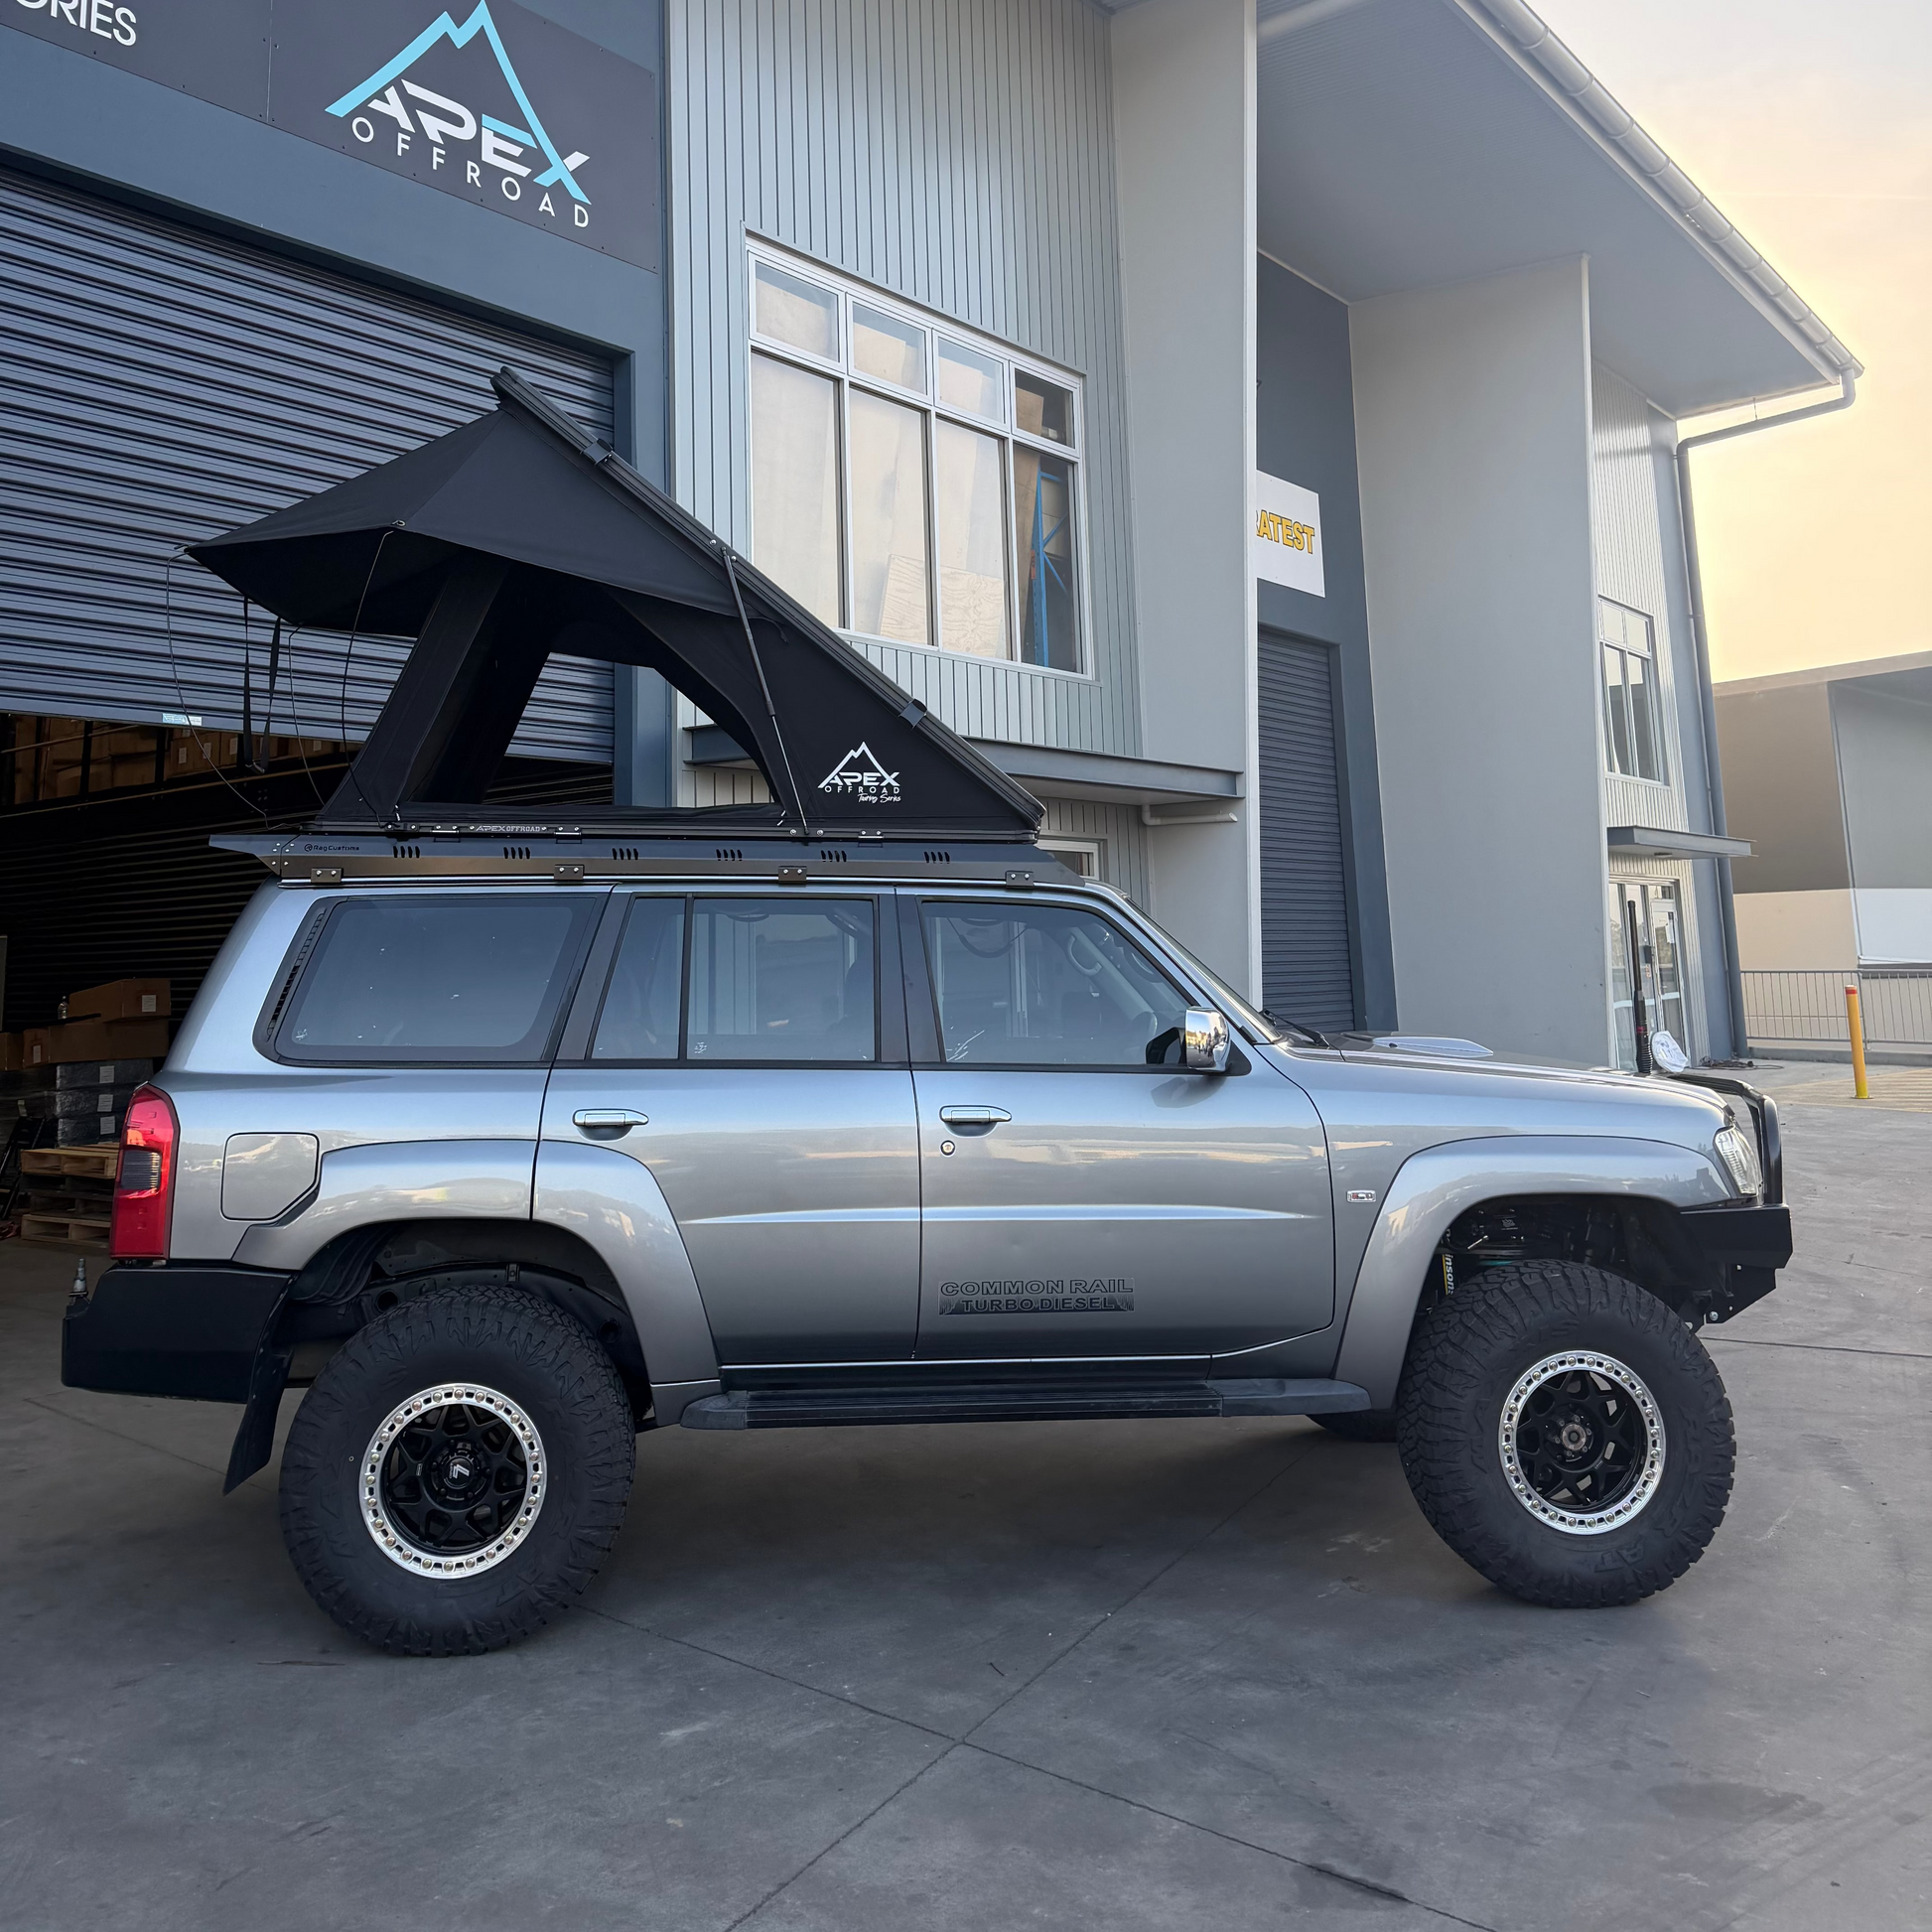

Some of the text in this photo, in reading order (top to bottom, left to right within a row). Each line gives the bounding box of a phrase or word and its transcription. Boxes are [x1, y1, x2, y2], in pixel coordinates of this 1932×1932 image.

[16, 0, 137, 47] RIES
[365, 77, 593, 206] APEX
[350, 116, 590, 228] OFFROAD
[1255, 508, 1315, 555] ATEST
[828, 771, 900, 786] APEX
[824, 785, 900, 794] OFFROAD
[880, 792, 901, 804] Series
[940, 1278, 1134, 1297] COMMON RAIL
[961, 1296, 1115, 1312] TURBO DIESEL
